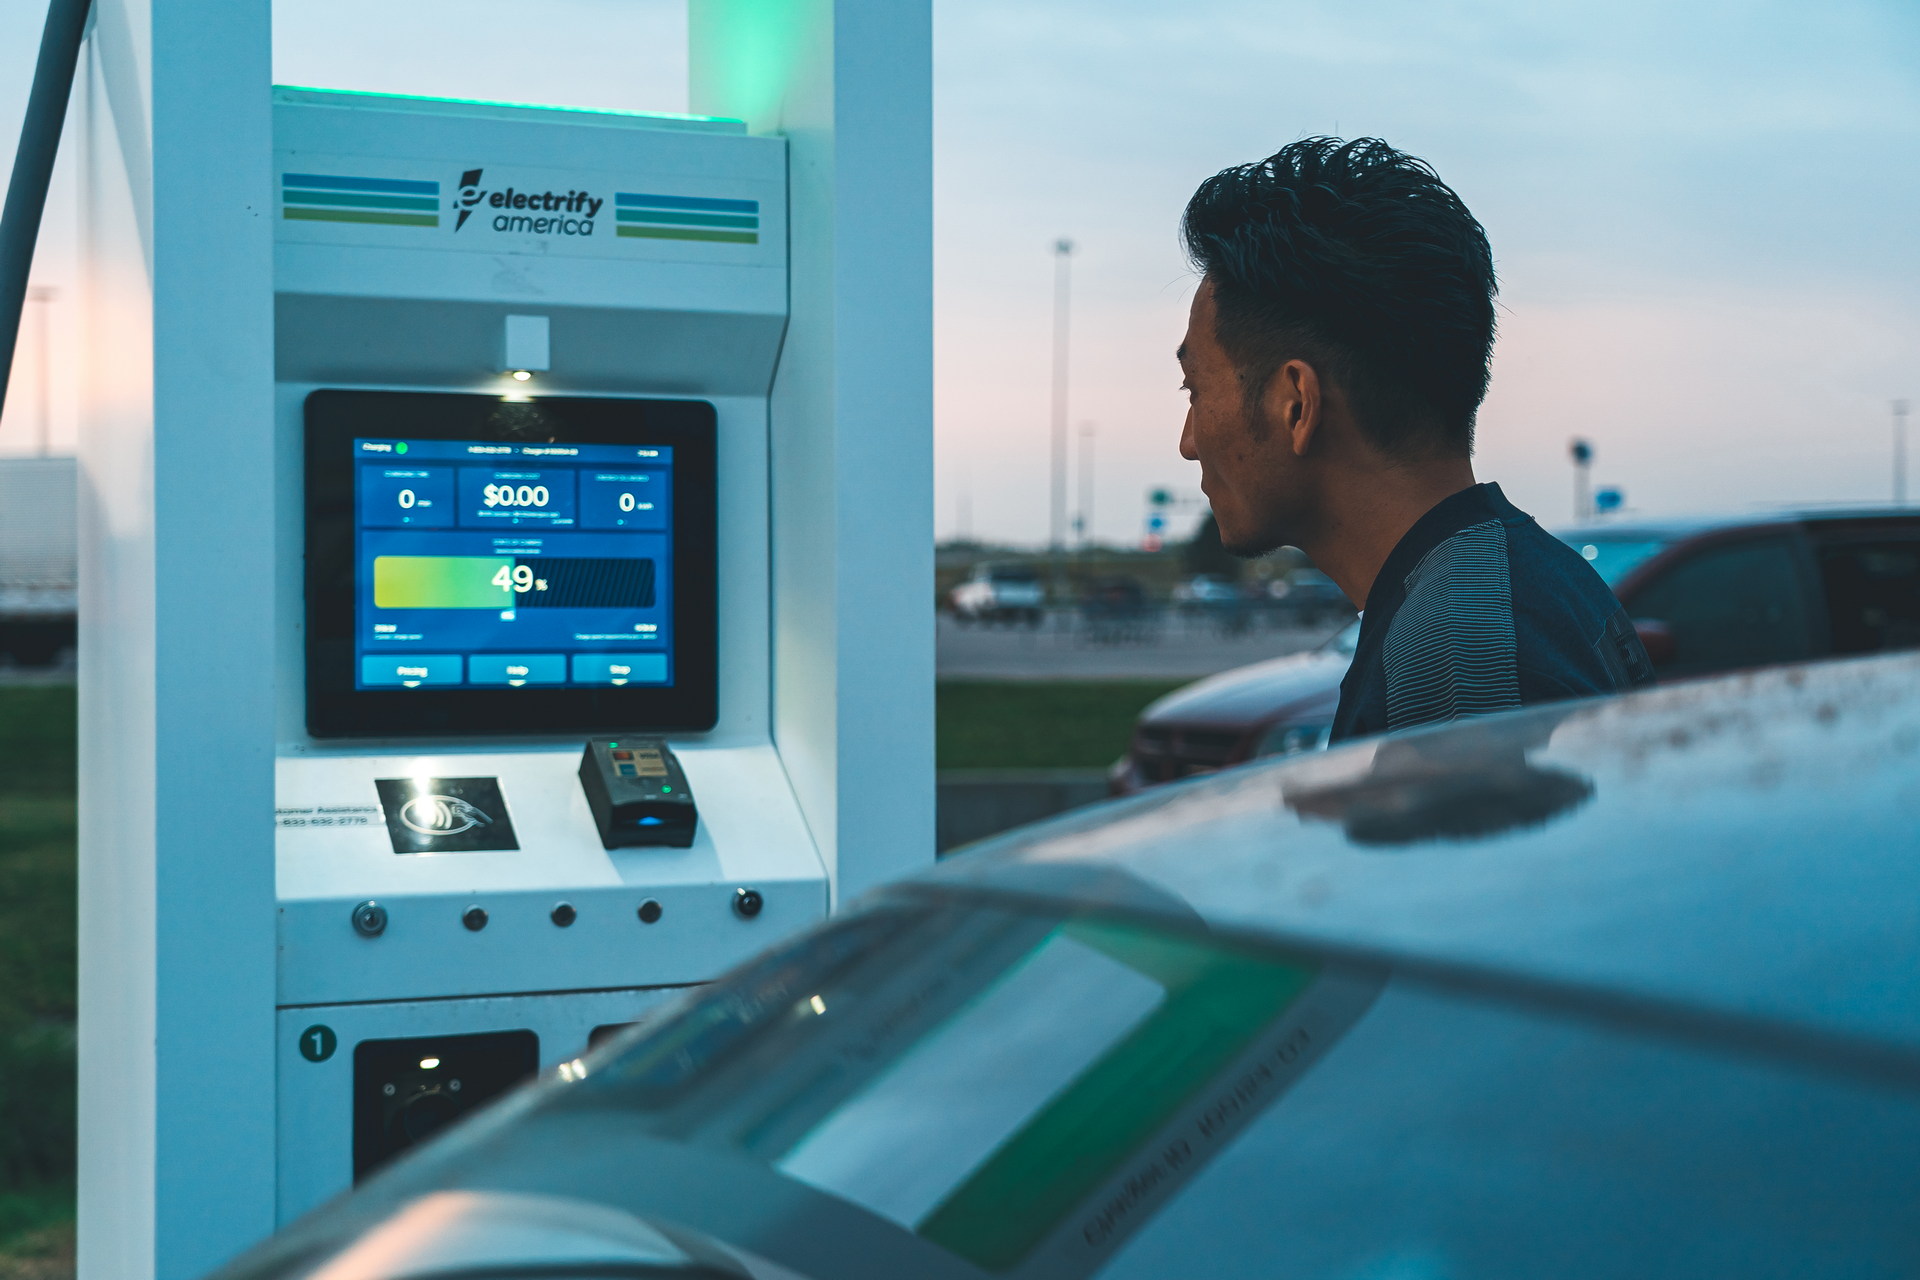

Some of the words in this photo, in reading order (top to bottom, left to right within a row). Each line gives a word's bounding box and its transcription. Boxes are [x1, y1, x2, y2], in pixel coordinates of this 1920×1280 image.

[489, 187, 604, 218] electrify
[492, 214, 595, 236] america
[398, 489, 416, 509] 0
[483, 483, 550, 508] $0.00
[619, 492, 635, 512] 0
[310, 1030, 325, 1056] 1
